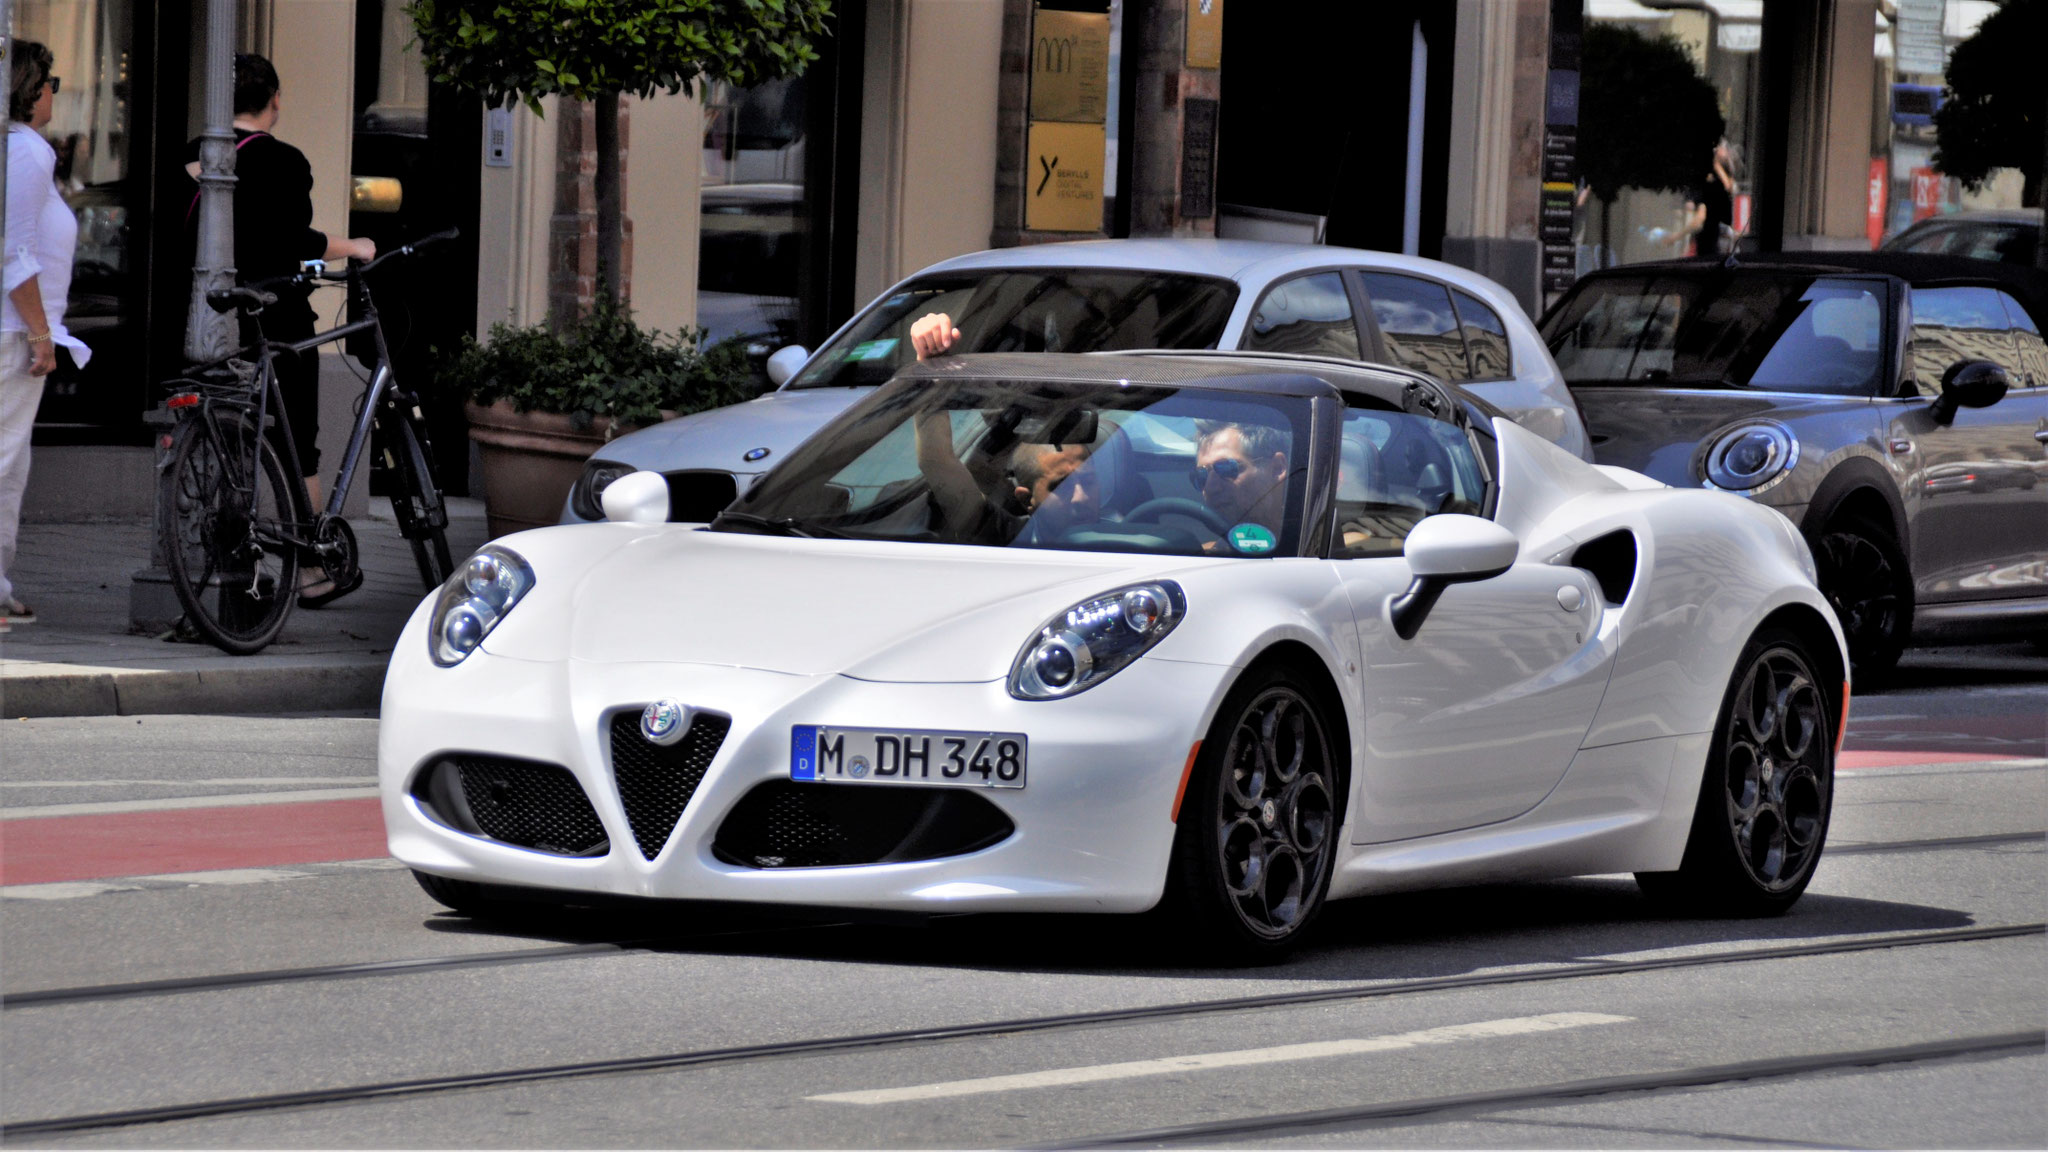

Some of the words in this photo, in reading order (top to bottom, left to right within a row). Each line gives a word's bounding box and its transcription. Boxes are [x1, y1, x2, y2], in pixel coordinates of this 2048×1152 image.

[1246, 527, 1257, 540] 4
[818, 733, 844, 774] M
[874, 735, 930, 778] DH
[941, 737, 1020, 781] 348
[799, 758, 808, 770] D
